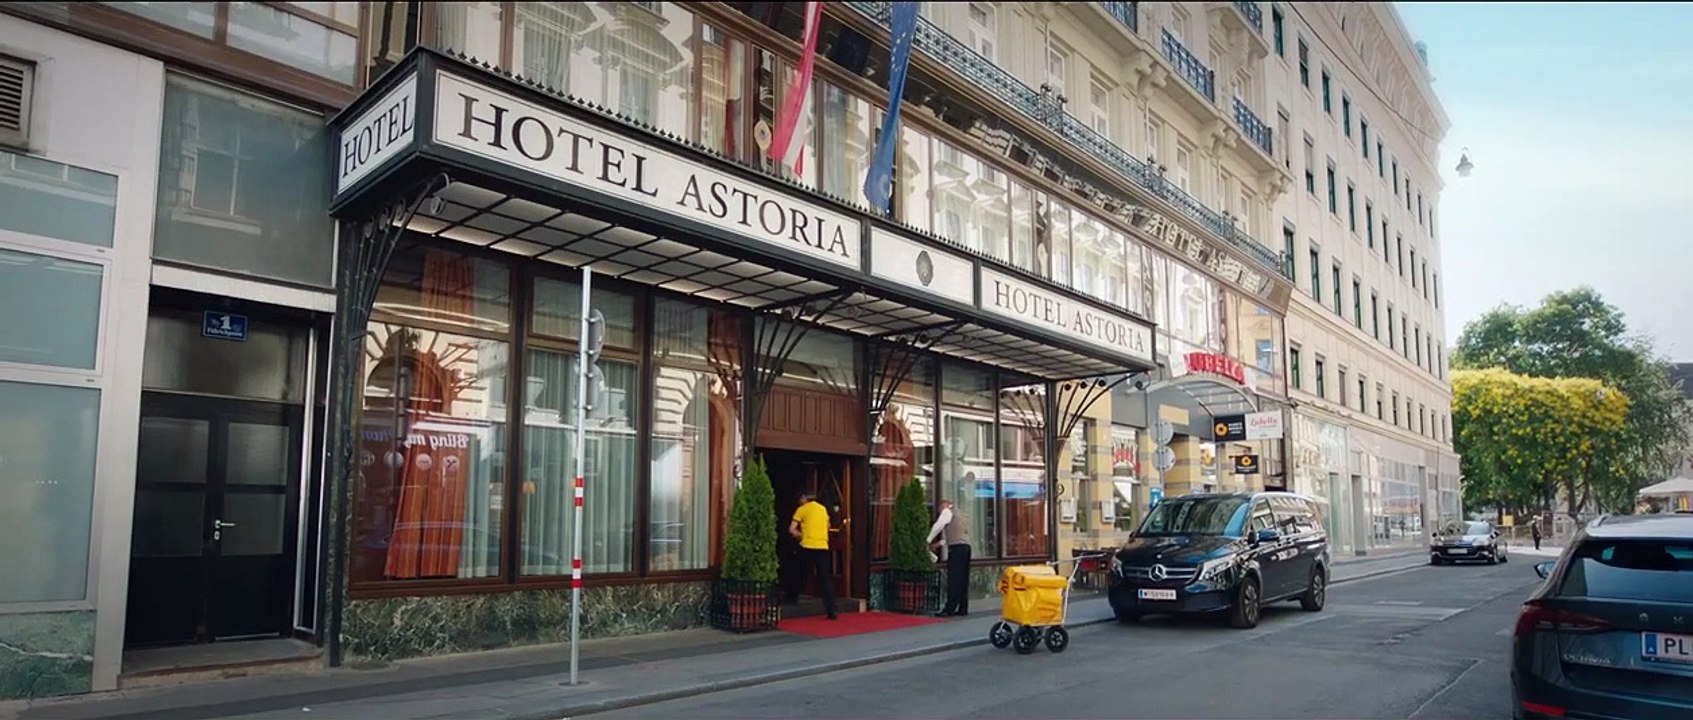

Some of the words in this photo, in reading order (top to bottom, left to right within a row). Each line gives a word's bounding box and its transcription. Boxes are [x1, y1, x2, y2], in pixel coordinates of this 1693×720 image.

[342, 96, 414, 178] HOTEL
[457, 92, 658, 197] HOTEL
[676, 173, 850, 258] ASTORIA
[221, 316, 231, 330] 1
[993, 280, 1067, 328] HOTEL
[1073, 308, 1144, 353] ASTORIA
